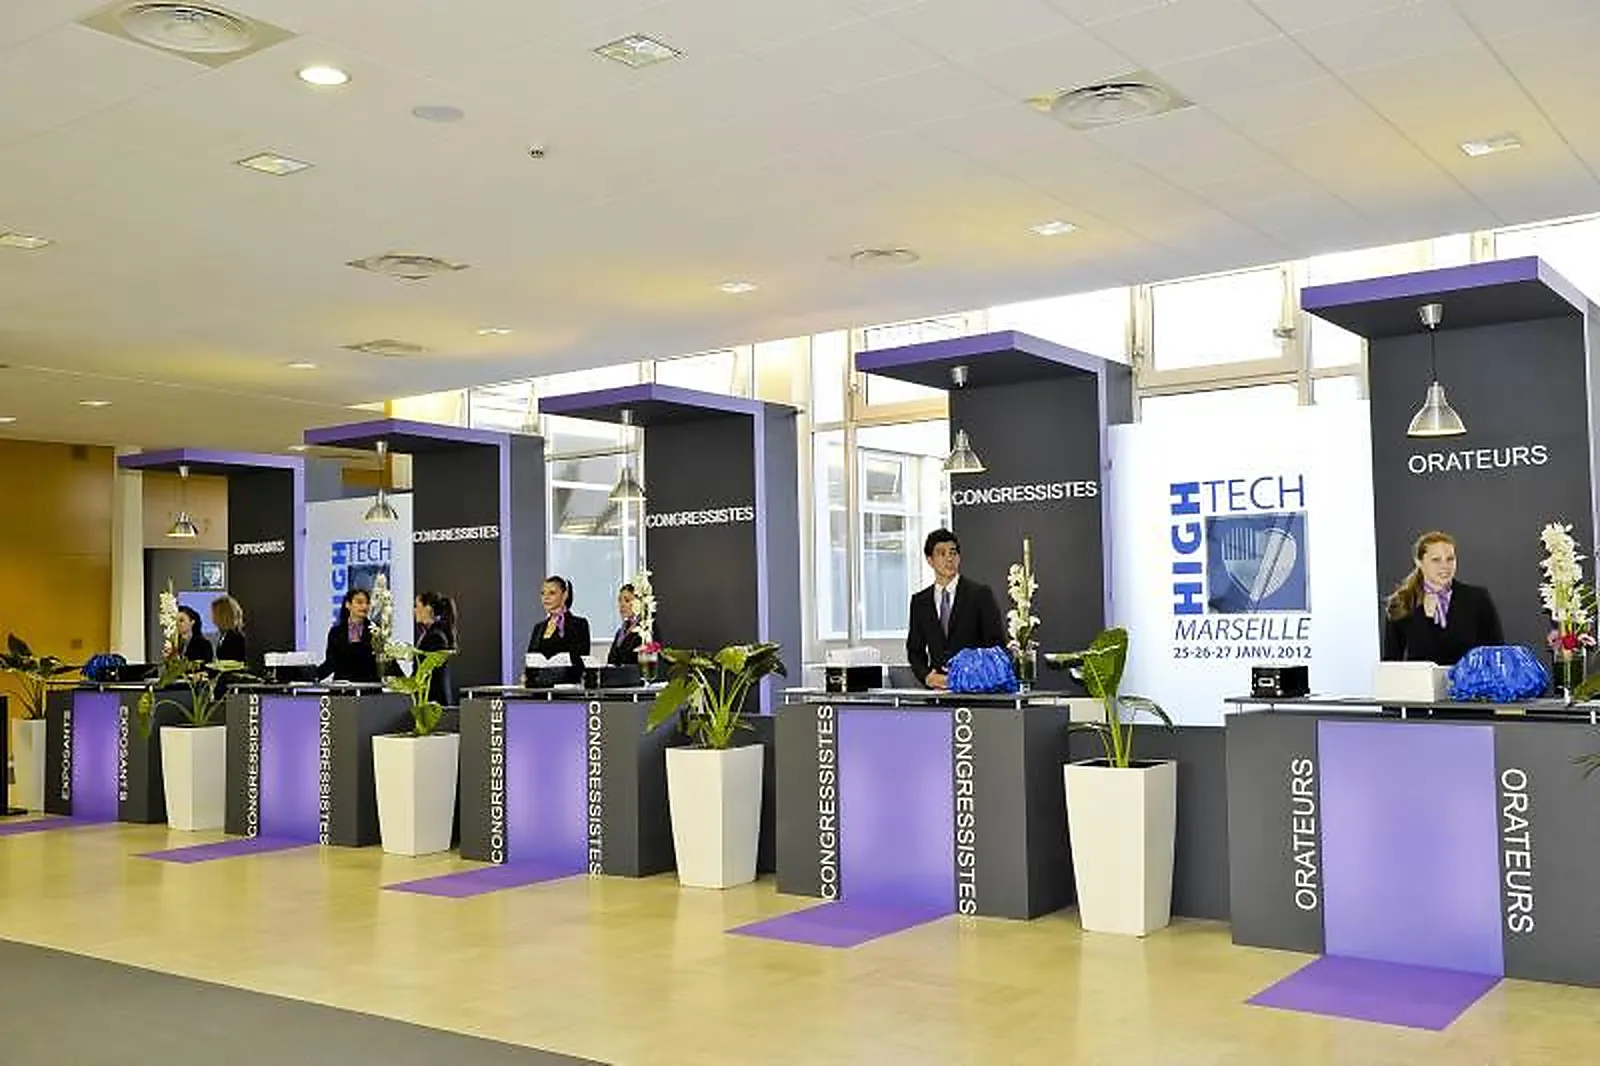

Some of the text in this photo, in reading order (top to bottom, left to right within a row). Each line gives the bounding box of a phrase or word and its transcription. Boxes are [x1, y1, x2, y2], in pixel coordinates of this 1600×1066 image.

[645, 505, 755, 528] CONGRESSISTES
[951, 480, 1098, 506] CONGRESSISTES
[1202, 473, 1305, 512] TECH
[1408, 445, 1548, 474] ORATEURS
[346, 539, 391, 562] TECH
[412, 525, 499, 543] CONGRESSISTES
[1169, 481, 1204, 615] HIGH
[1173, 646, 1312, 659] 25-26-27 JANV. 2012
[1174, 617, 1312, 640] MARSEILLE
[247, 694, 259, 839] CONGRESSISTES
[320, 695, 331, 845] CONGRESSISTES
[491, 699, 503, 863] CONGRESSISTES
[589, 701, 601, 876] CONGRESSISTES
[817, 705, 837, 899] CONGRESSISTES
[955, 707, 977, 915] CONGRESSISTES
[1291, 758, 1317, 910] ORATEURS
[1501, 768, 1534, 932] ORATEURS
